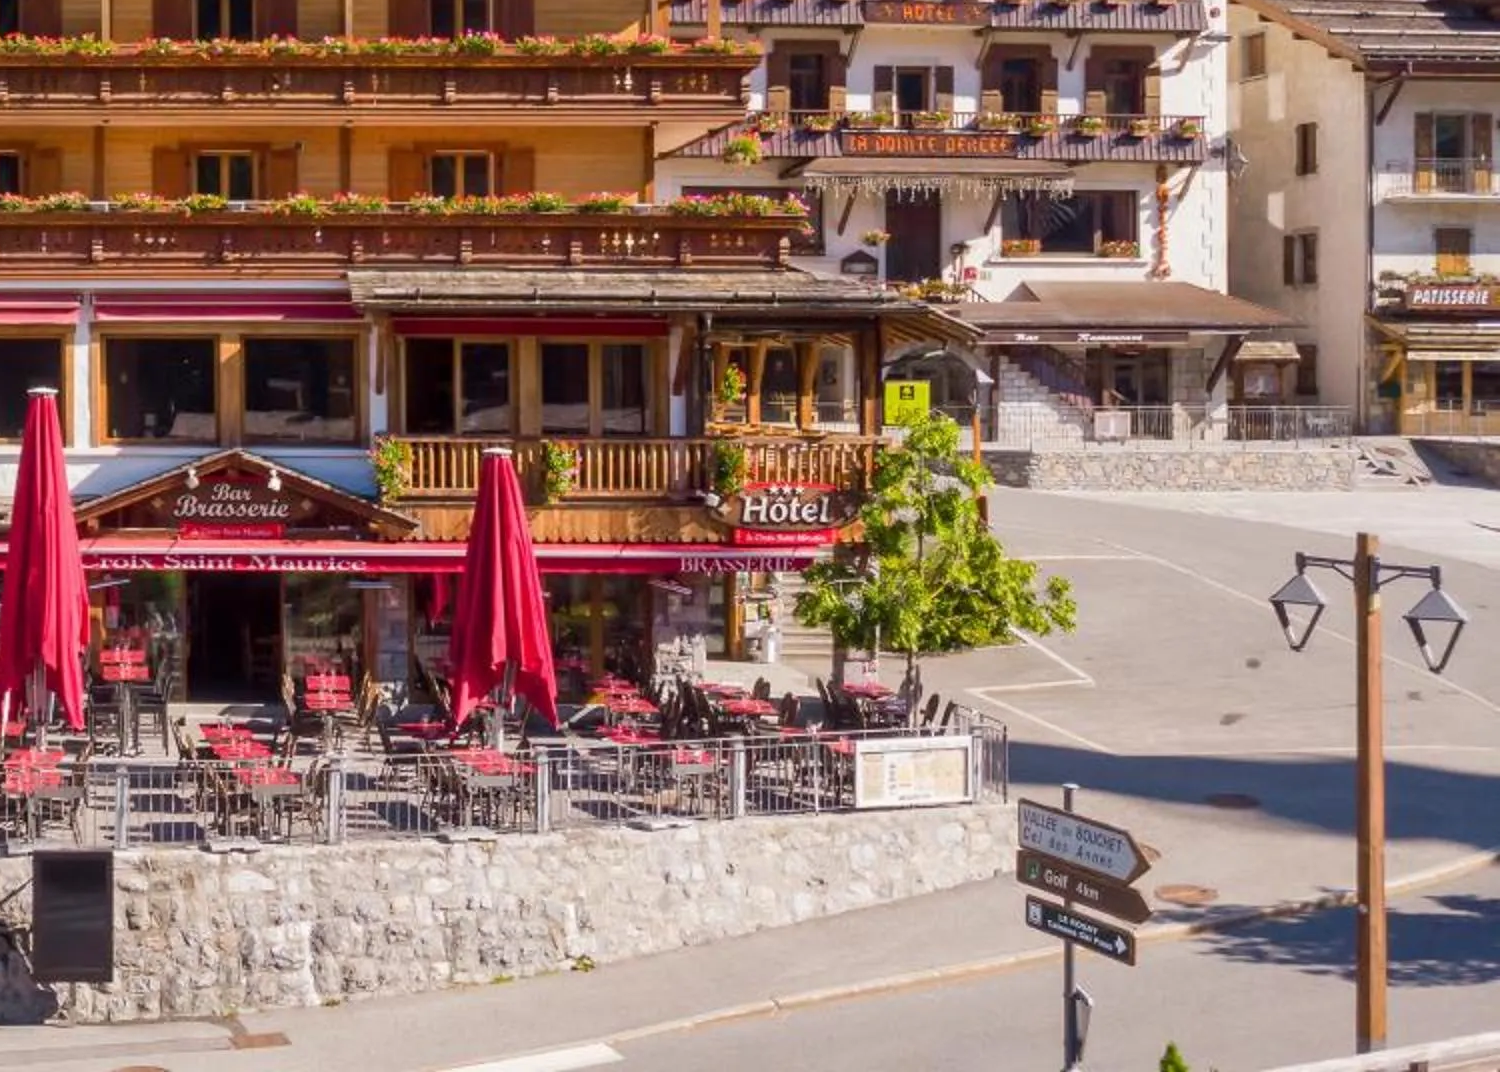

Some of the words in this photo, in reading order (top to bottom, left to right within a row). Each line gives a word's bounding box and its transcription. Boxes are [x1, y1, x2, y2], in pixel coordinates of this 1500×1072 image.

[211, 483, 252, 501] Bar
[173, 494, 290, 517] Brasserie
[742, 495, 830, 523] Hôtel
[163, 554, 234, 570] Saint
[249, 555, 367, 572] Maurice
[680, 557, 795, 573] BRASSERIE
[1043, 868, 1069, 889] Golf
